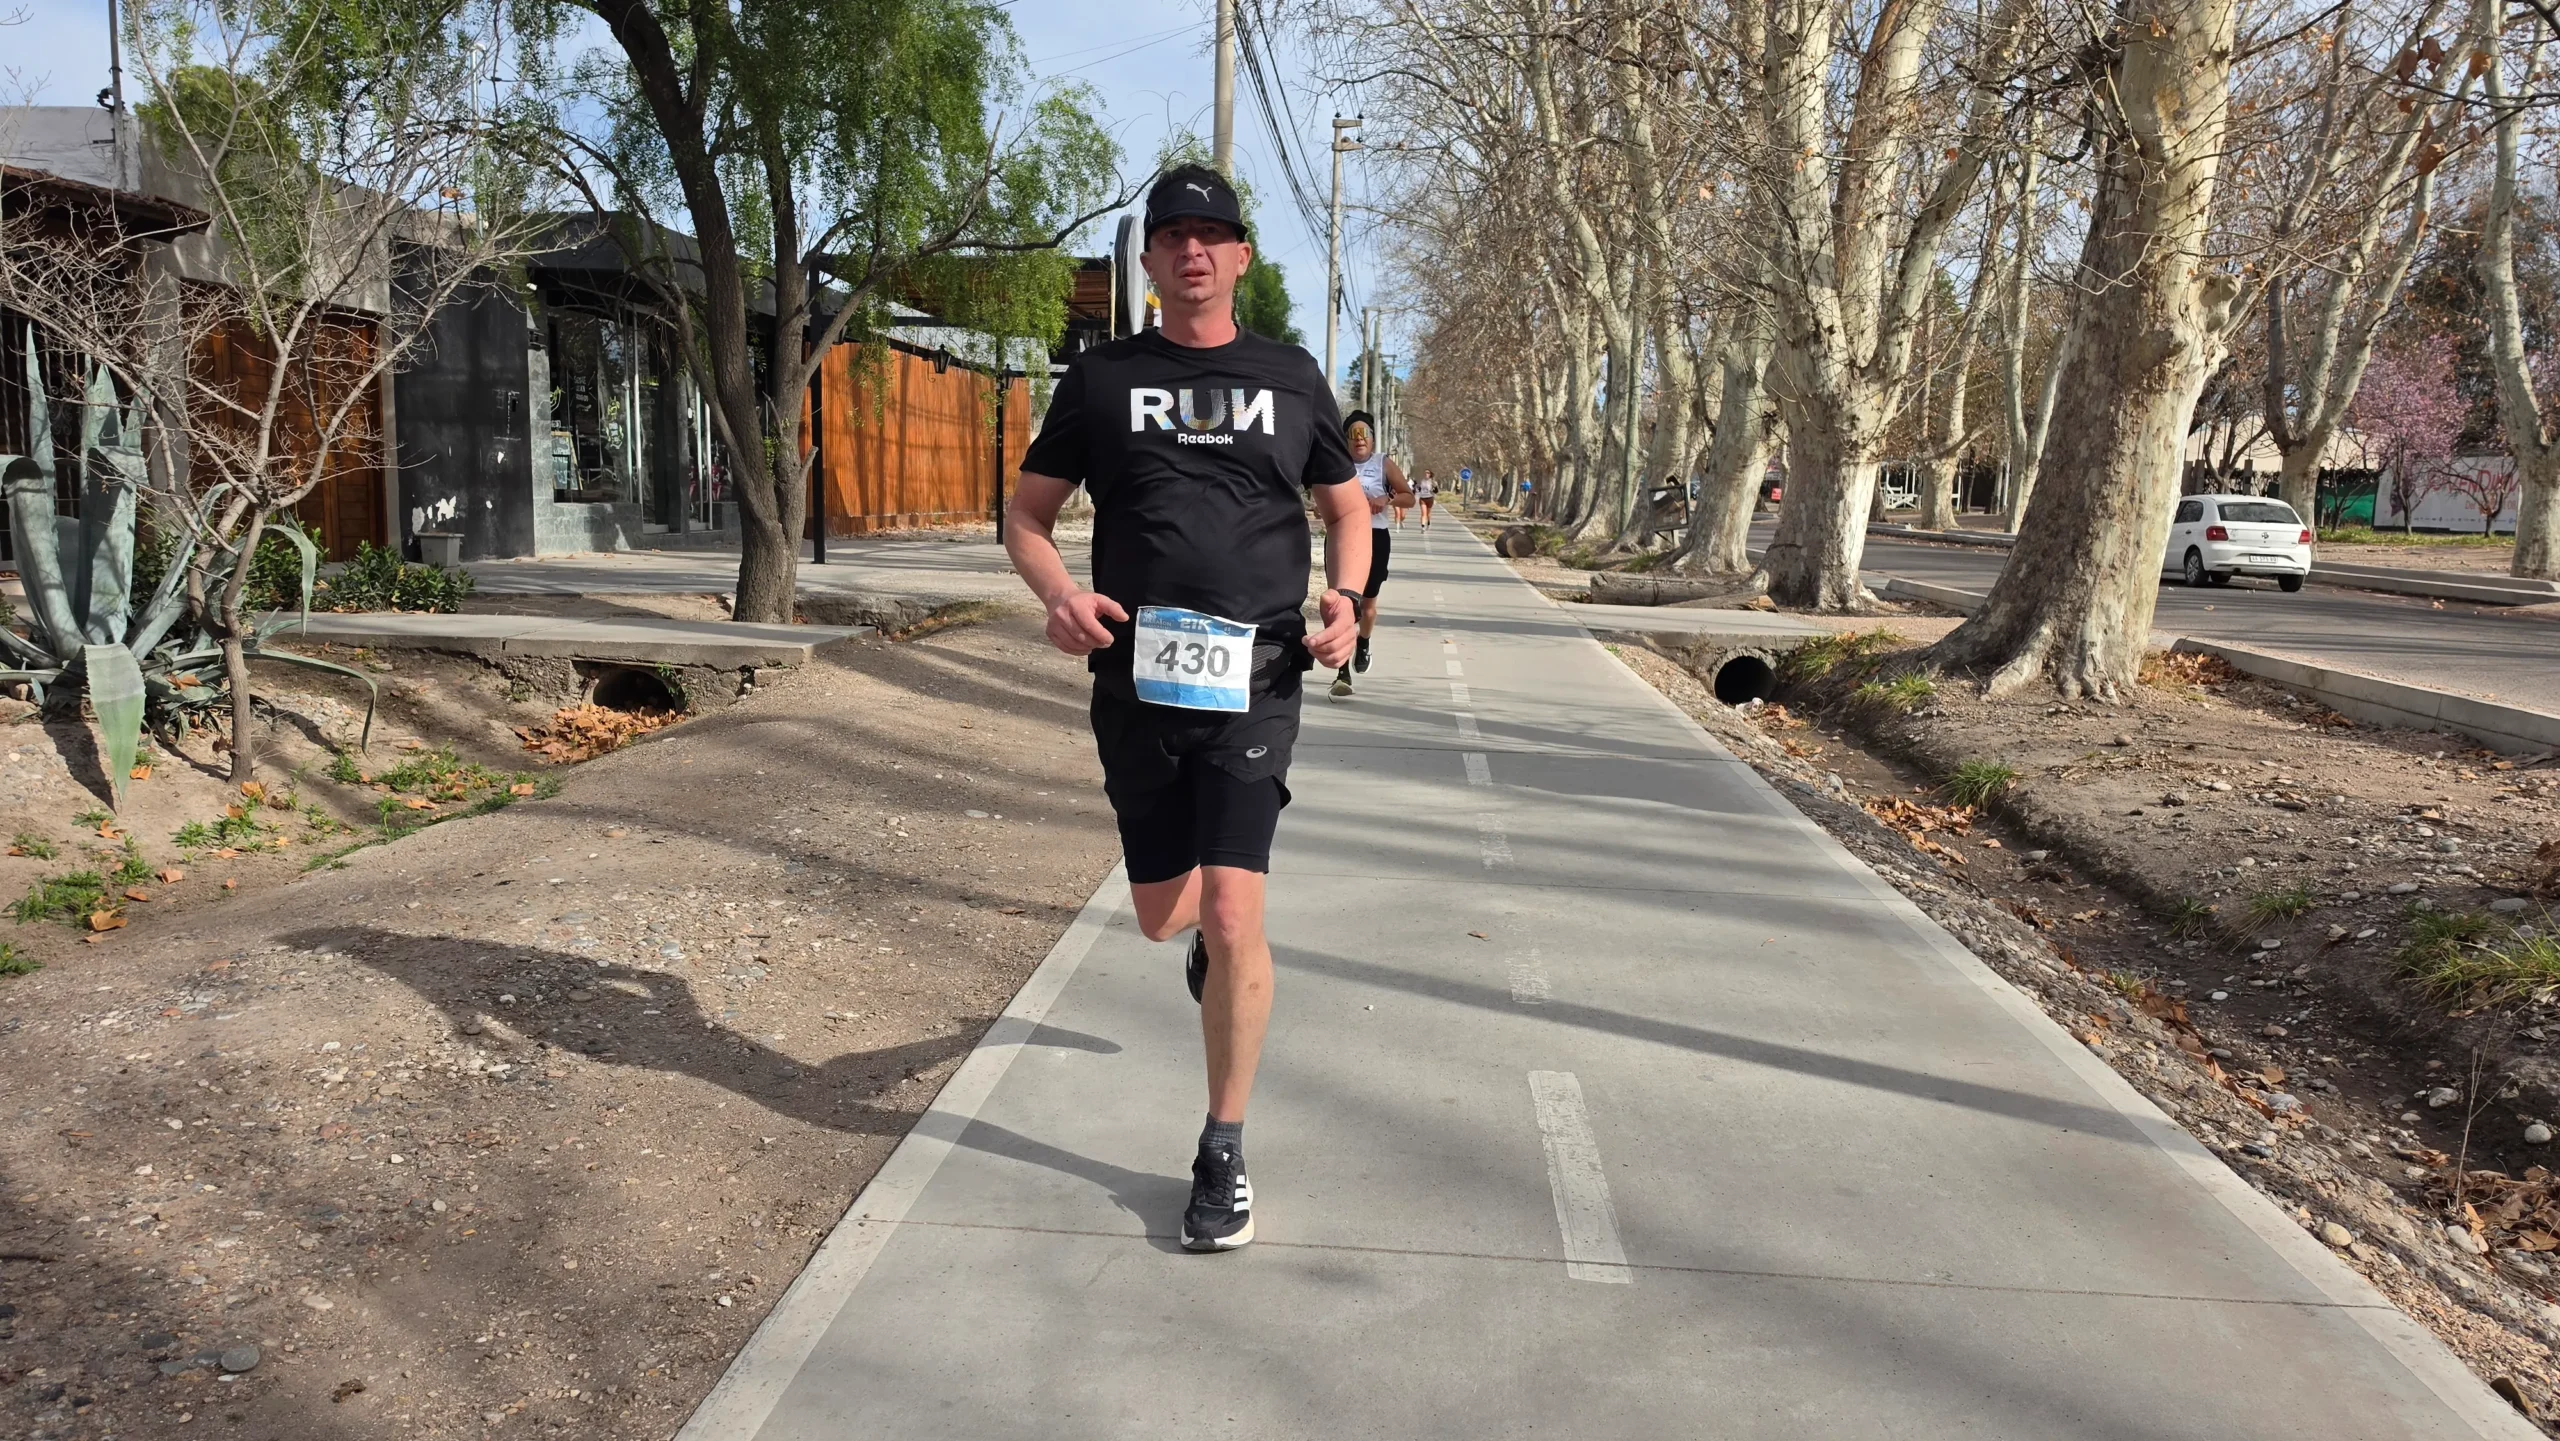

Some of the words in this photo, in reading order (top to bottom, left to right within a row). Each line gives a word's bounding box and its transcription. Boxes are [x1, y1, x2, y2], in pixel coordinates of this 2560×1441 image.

[1177, 432, 1234, 445] Reebok
[1180, 618, 1213, 630] 21K
[1155, 641, 1230, 677] 430
